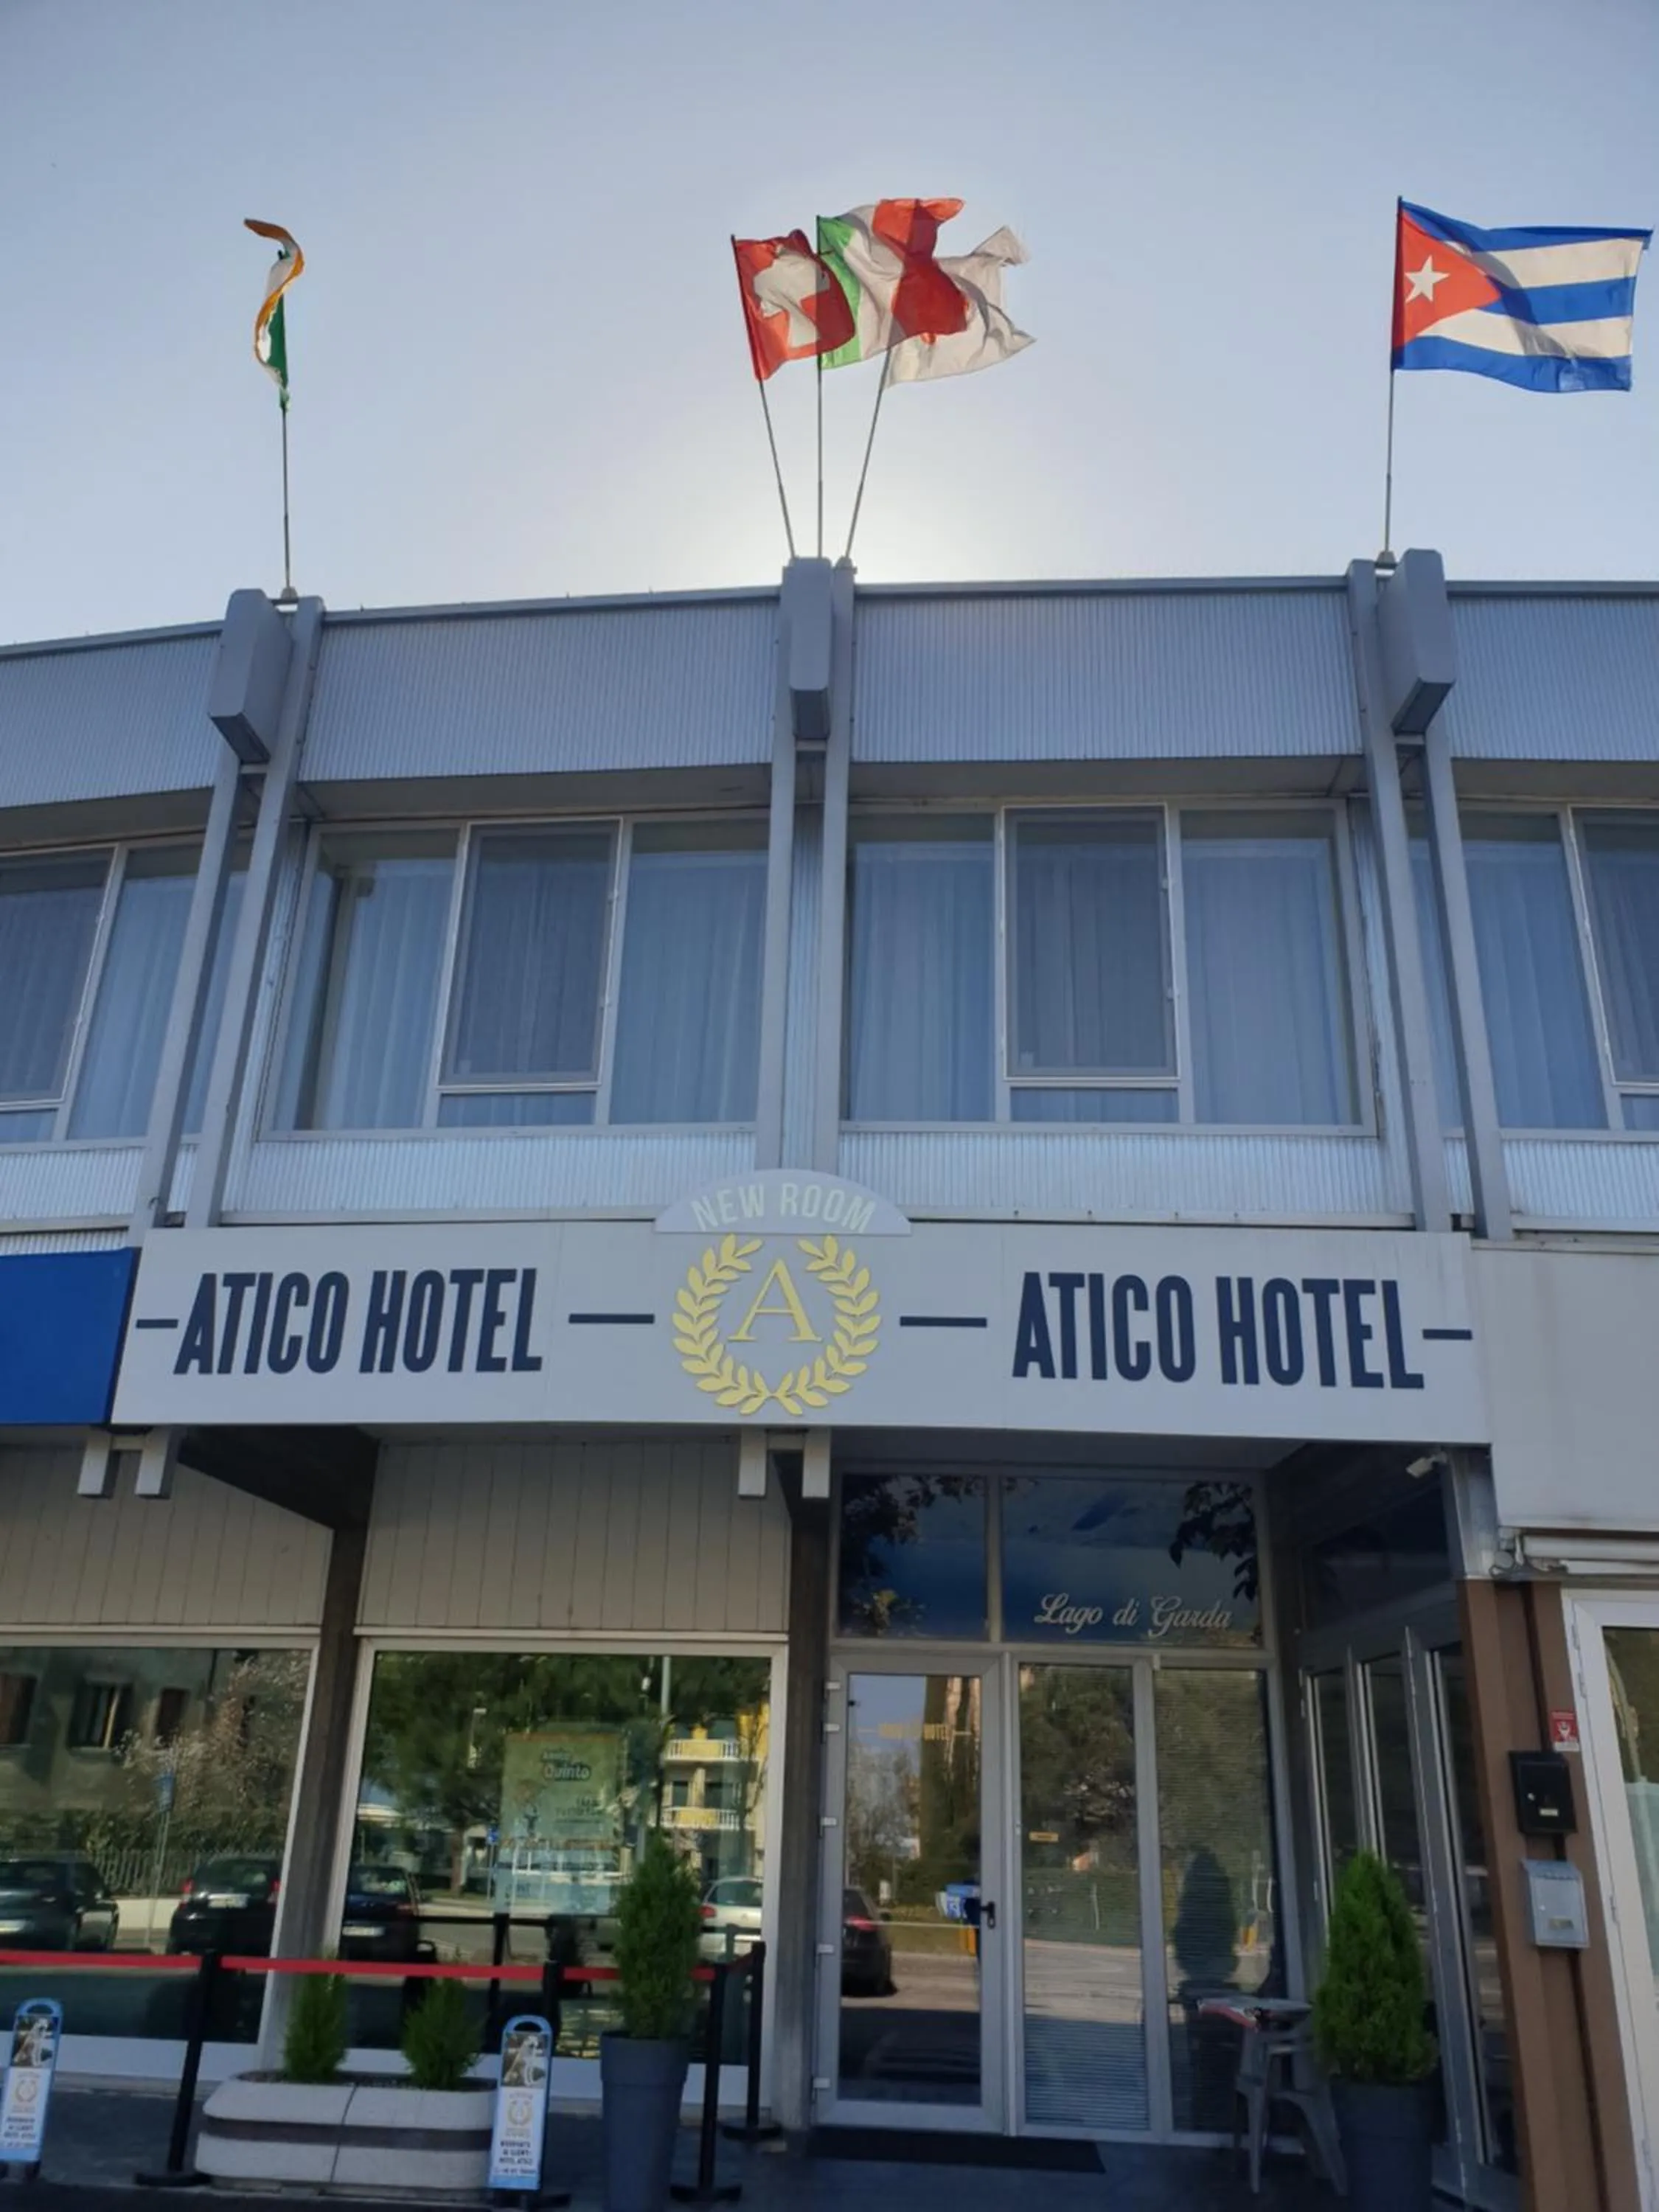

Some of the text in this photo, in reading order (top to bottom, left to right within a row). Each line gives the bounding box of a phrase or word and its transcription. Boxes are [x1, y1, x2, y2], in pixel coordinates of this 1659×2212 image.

[690, 1182, 876, 1233] NEW ROOM
[173, 1268, 543, 1374] ATICO HOTEL
[727, 1258, 824, 1342] A
[1012, 1272, 1425, 1389] ATICO HOTEL
[1034, 1593, 1234, 1638] Lago di Garda
